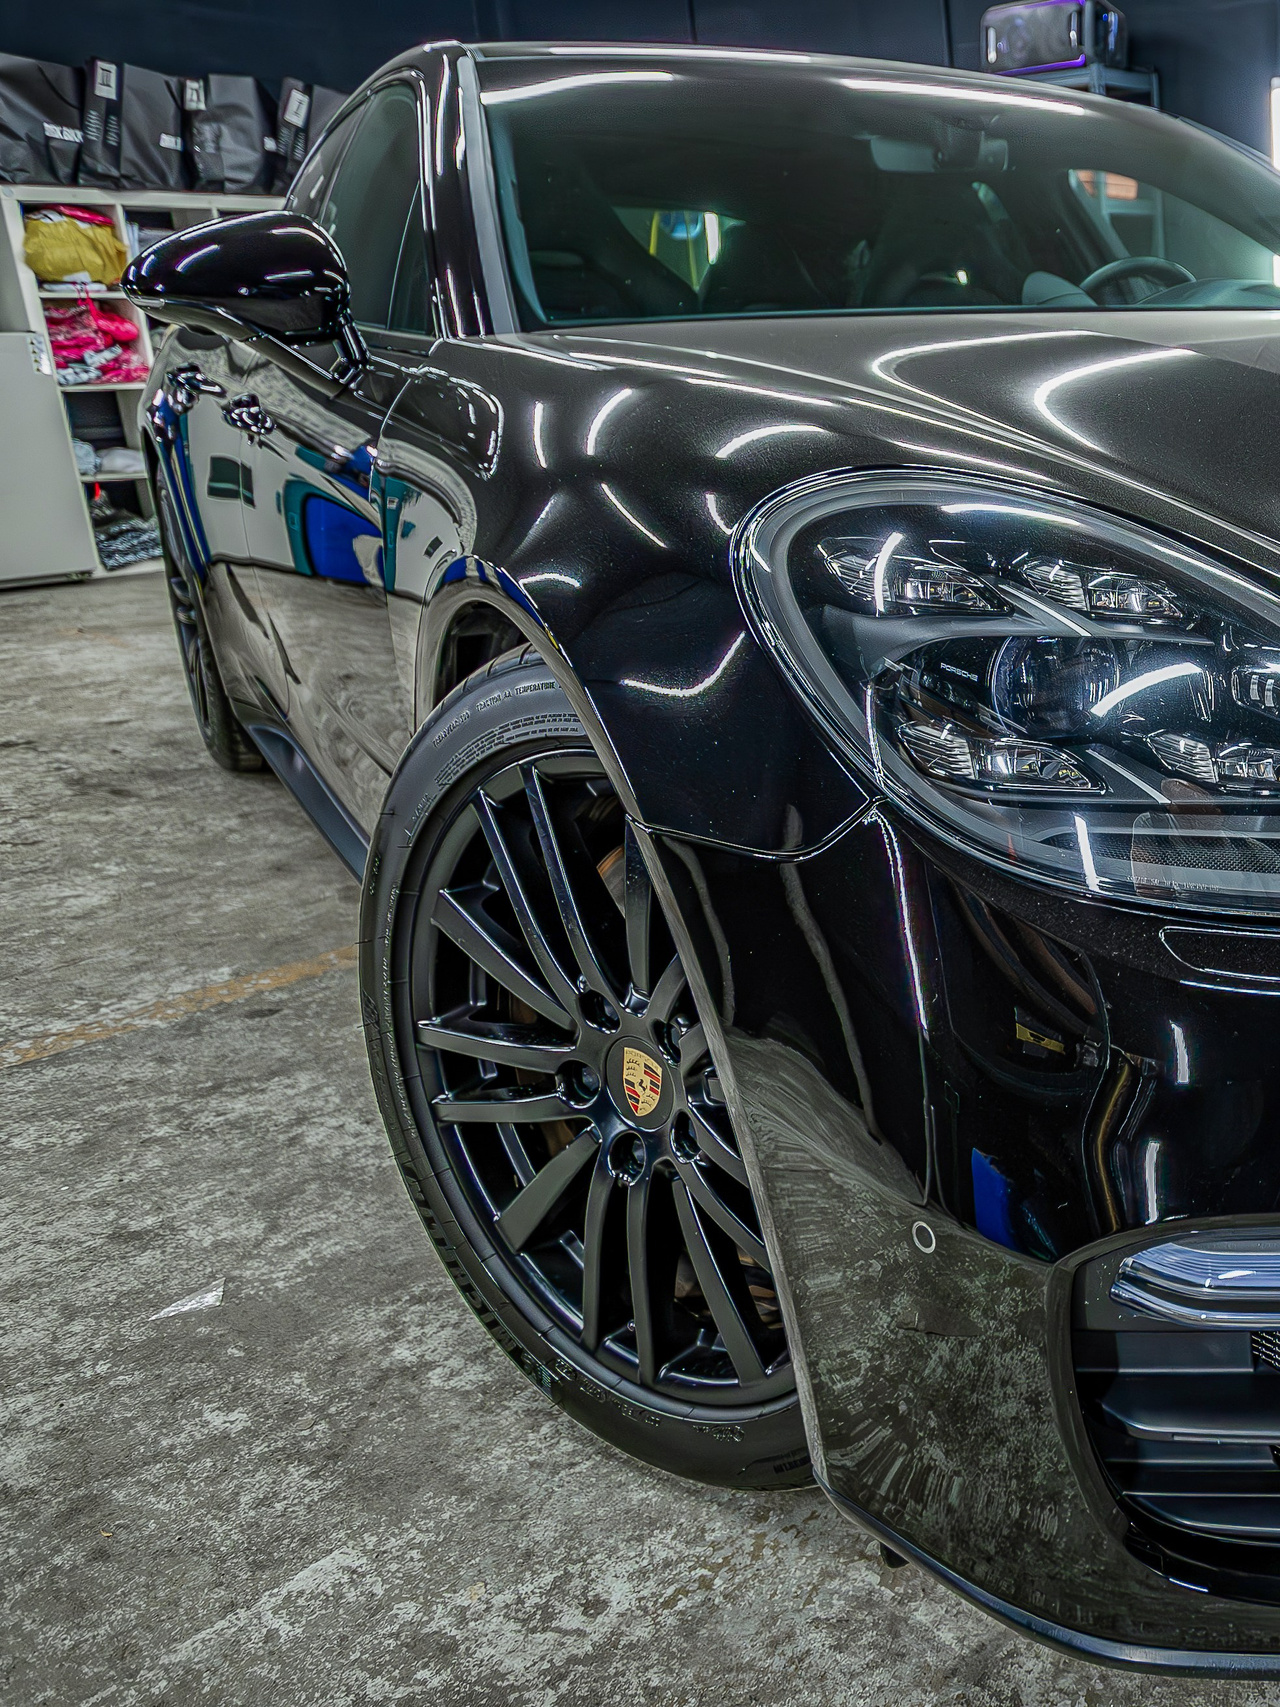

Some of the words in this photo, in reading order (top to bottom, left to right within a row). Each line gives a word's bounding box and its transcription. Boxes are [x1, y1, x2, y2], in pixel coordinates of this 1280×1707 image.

[940, 661, 978, 682] PORSCHE
[475, 692, 501, 712] TRACTION
[514, 681, 556, 696] TEMPERATURE
